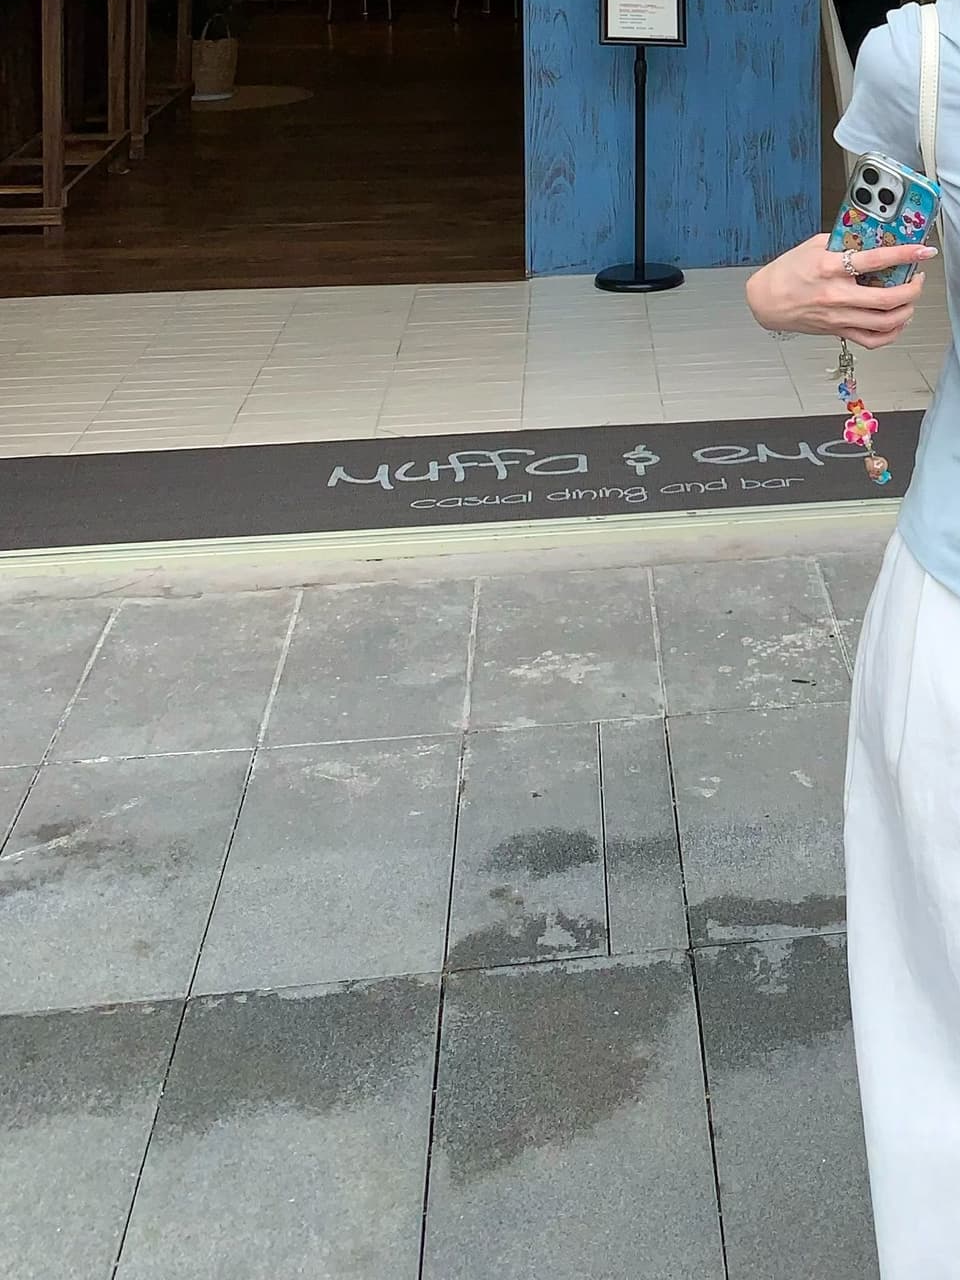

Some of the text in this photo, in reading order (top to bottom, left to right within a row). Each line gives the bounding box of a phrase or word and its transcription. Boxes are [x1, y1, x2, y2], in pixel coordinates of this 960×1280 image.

[409, 476, 805, 510] casual dining and bar
